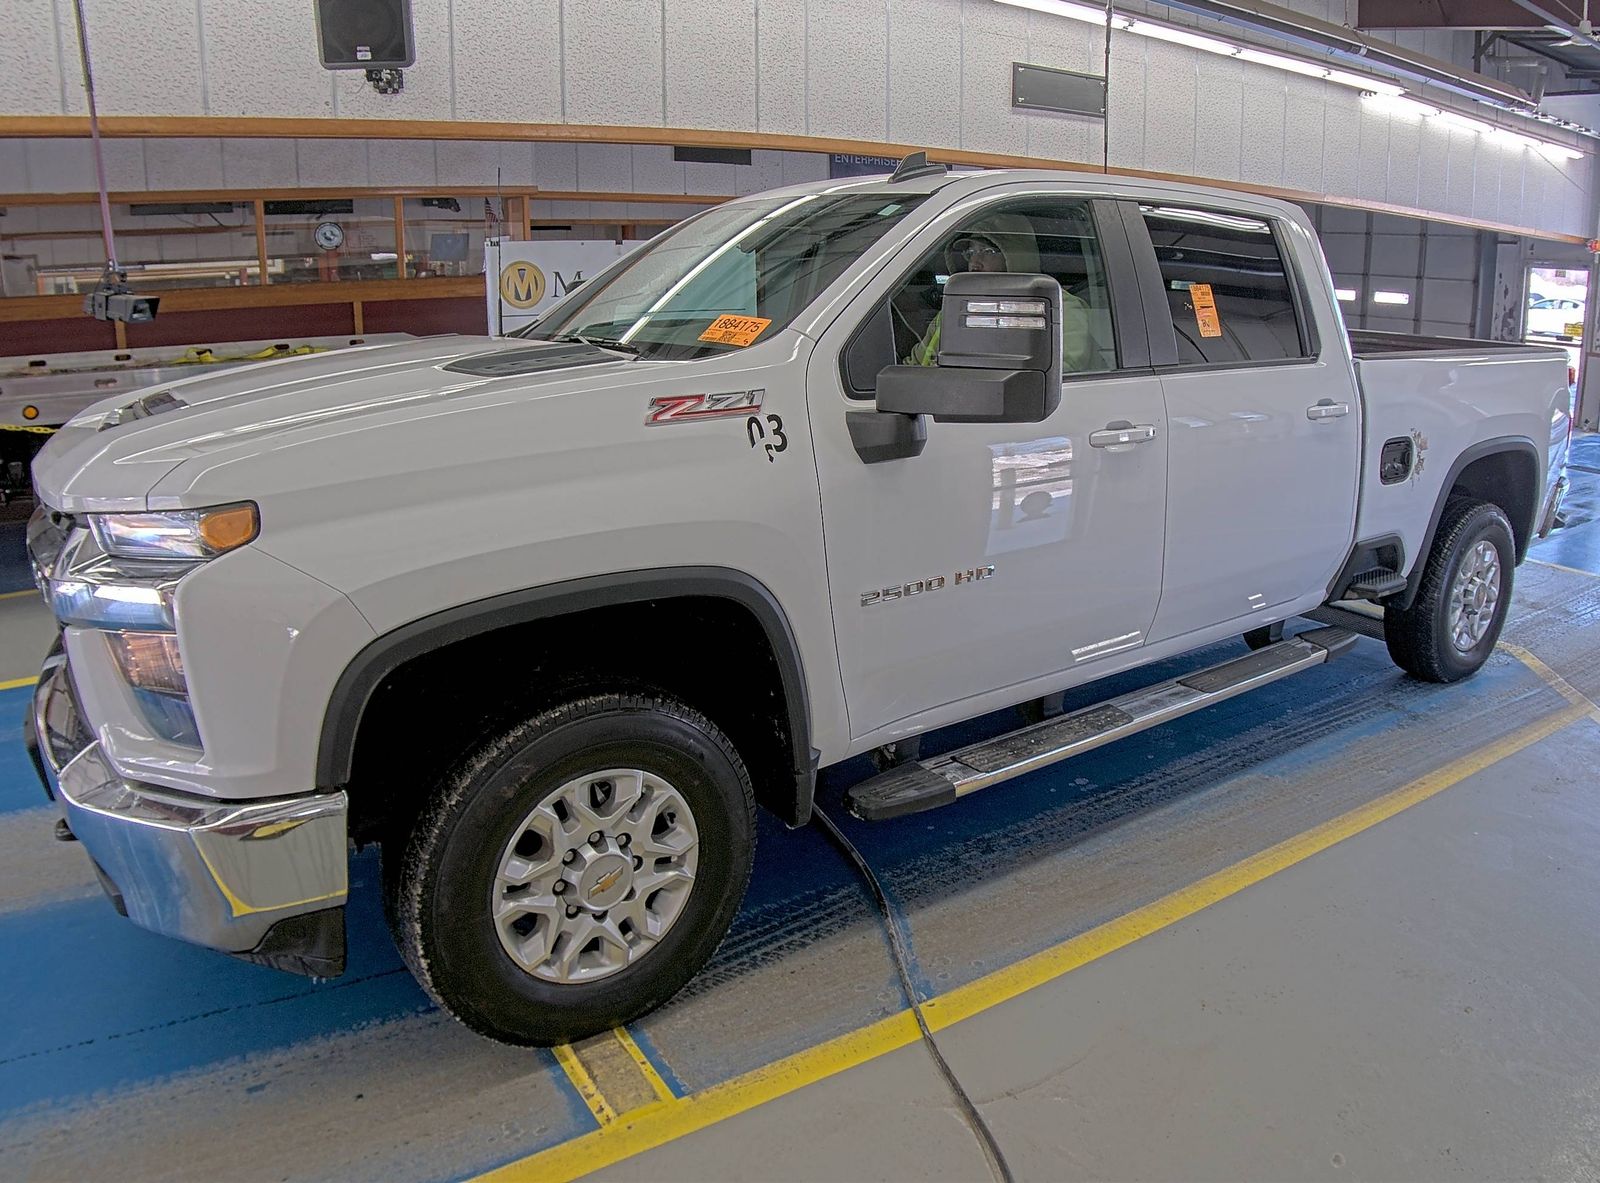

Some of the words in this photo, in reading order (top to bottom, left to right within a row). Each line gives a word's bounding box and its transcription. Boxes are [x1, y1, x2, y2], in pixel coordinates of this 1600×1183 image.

[714, 318, 763, 333] 1884175
[645, 388, 765, 426] Z71
[860, 575, 945, 607] 2500
[954, 564, 995, 585] HD
